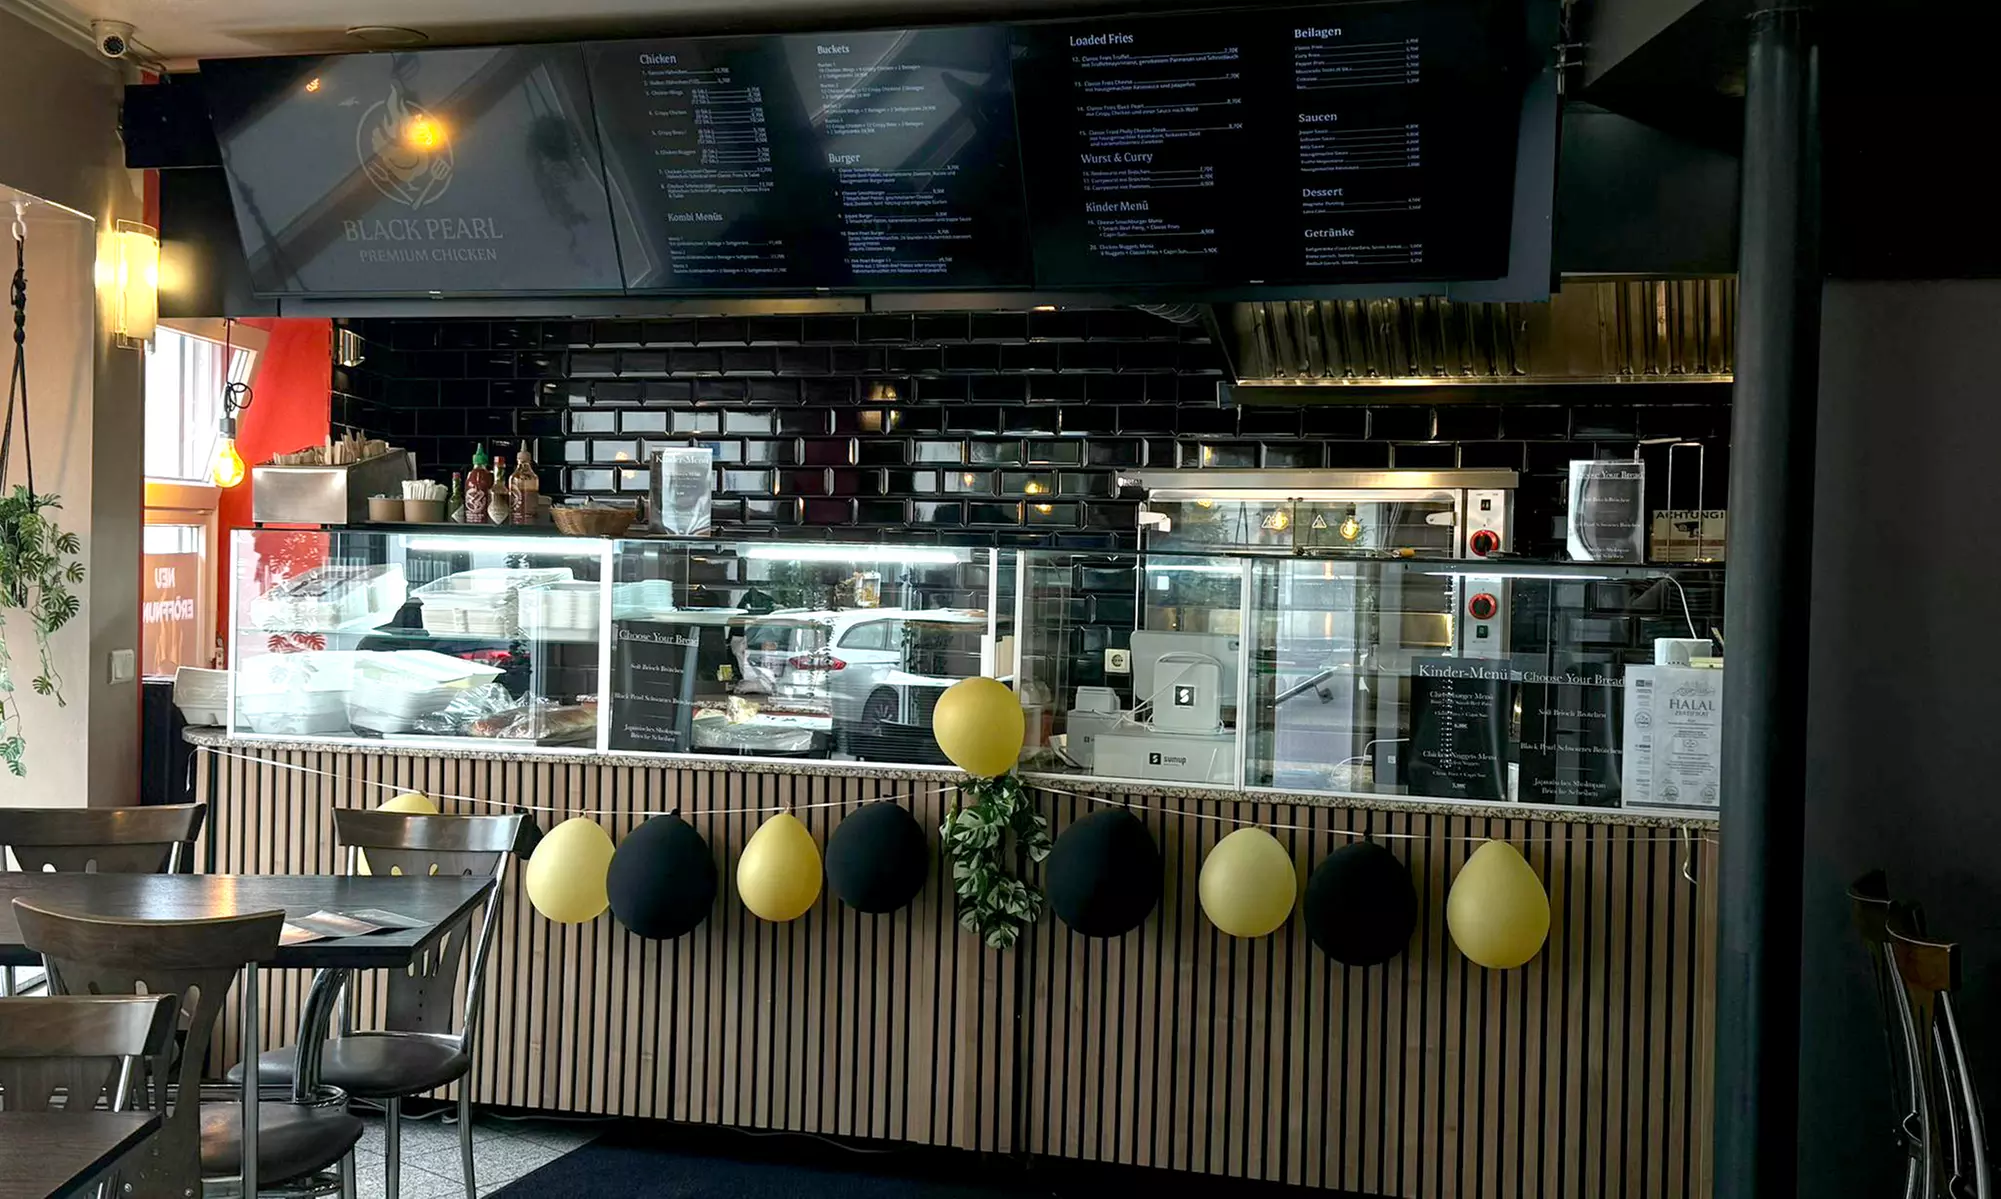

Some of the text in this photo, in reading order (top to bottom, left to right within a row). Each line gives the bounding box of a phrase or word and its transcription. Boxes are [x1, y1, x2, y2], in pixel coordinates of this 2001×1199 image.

[1069, 32, 1134, 46] Loaded Fries
[1294, 27, 1342, 39] Beilagen
[817, 44, 850, 55] Buckets
[639, 54, 677, 65] Chicken
[1298, 112, 1338, 123] Saucen
[828, 152, 861, 165] Burger
[1081, 151, 1153, 164] Wurst & Curry
[1302, 187, 1344, 197] Dessert
[1085, 200, 1149, 212] Kinder Menü
[667, 211, 723, 223] Kombi Menüs
[343, 217, 503, 241] BLACK PEARL
[1304, 227, 1355, 238] Getränke
[359, 248, 497, 263] PREMIUM CHICKEN
[619, 629, 699, 646] Choose Your Bread
[1419, 664, 1508, 680] Kinder-Menü
[1523, 671, 1562, 682] Choose
[1566, 673, 1591, 684] Your
[1669, 698, 1715, 711] HALAL
[1163, 754, 1187, 766] sumup
